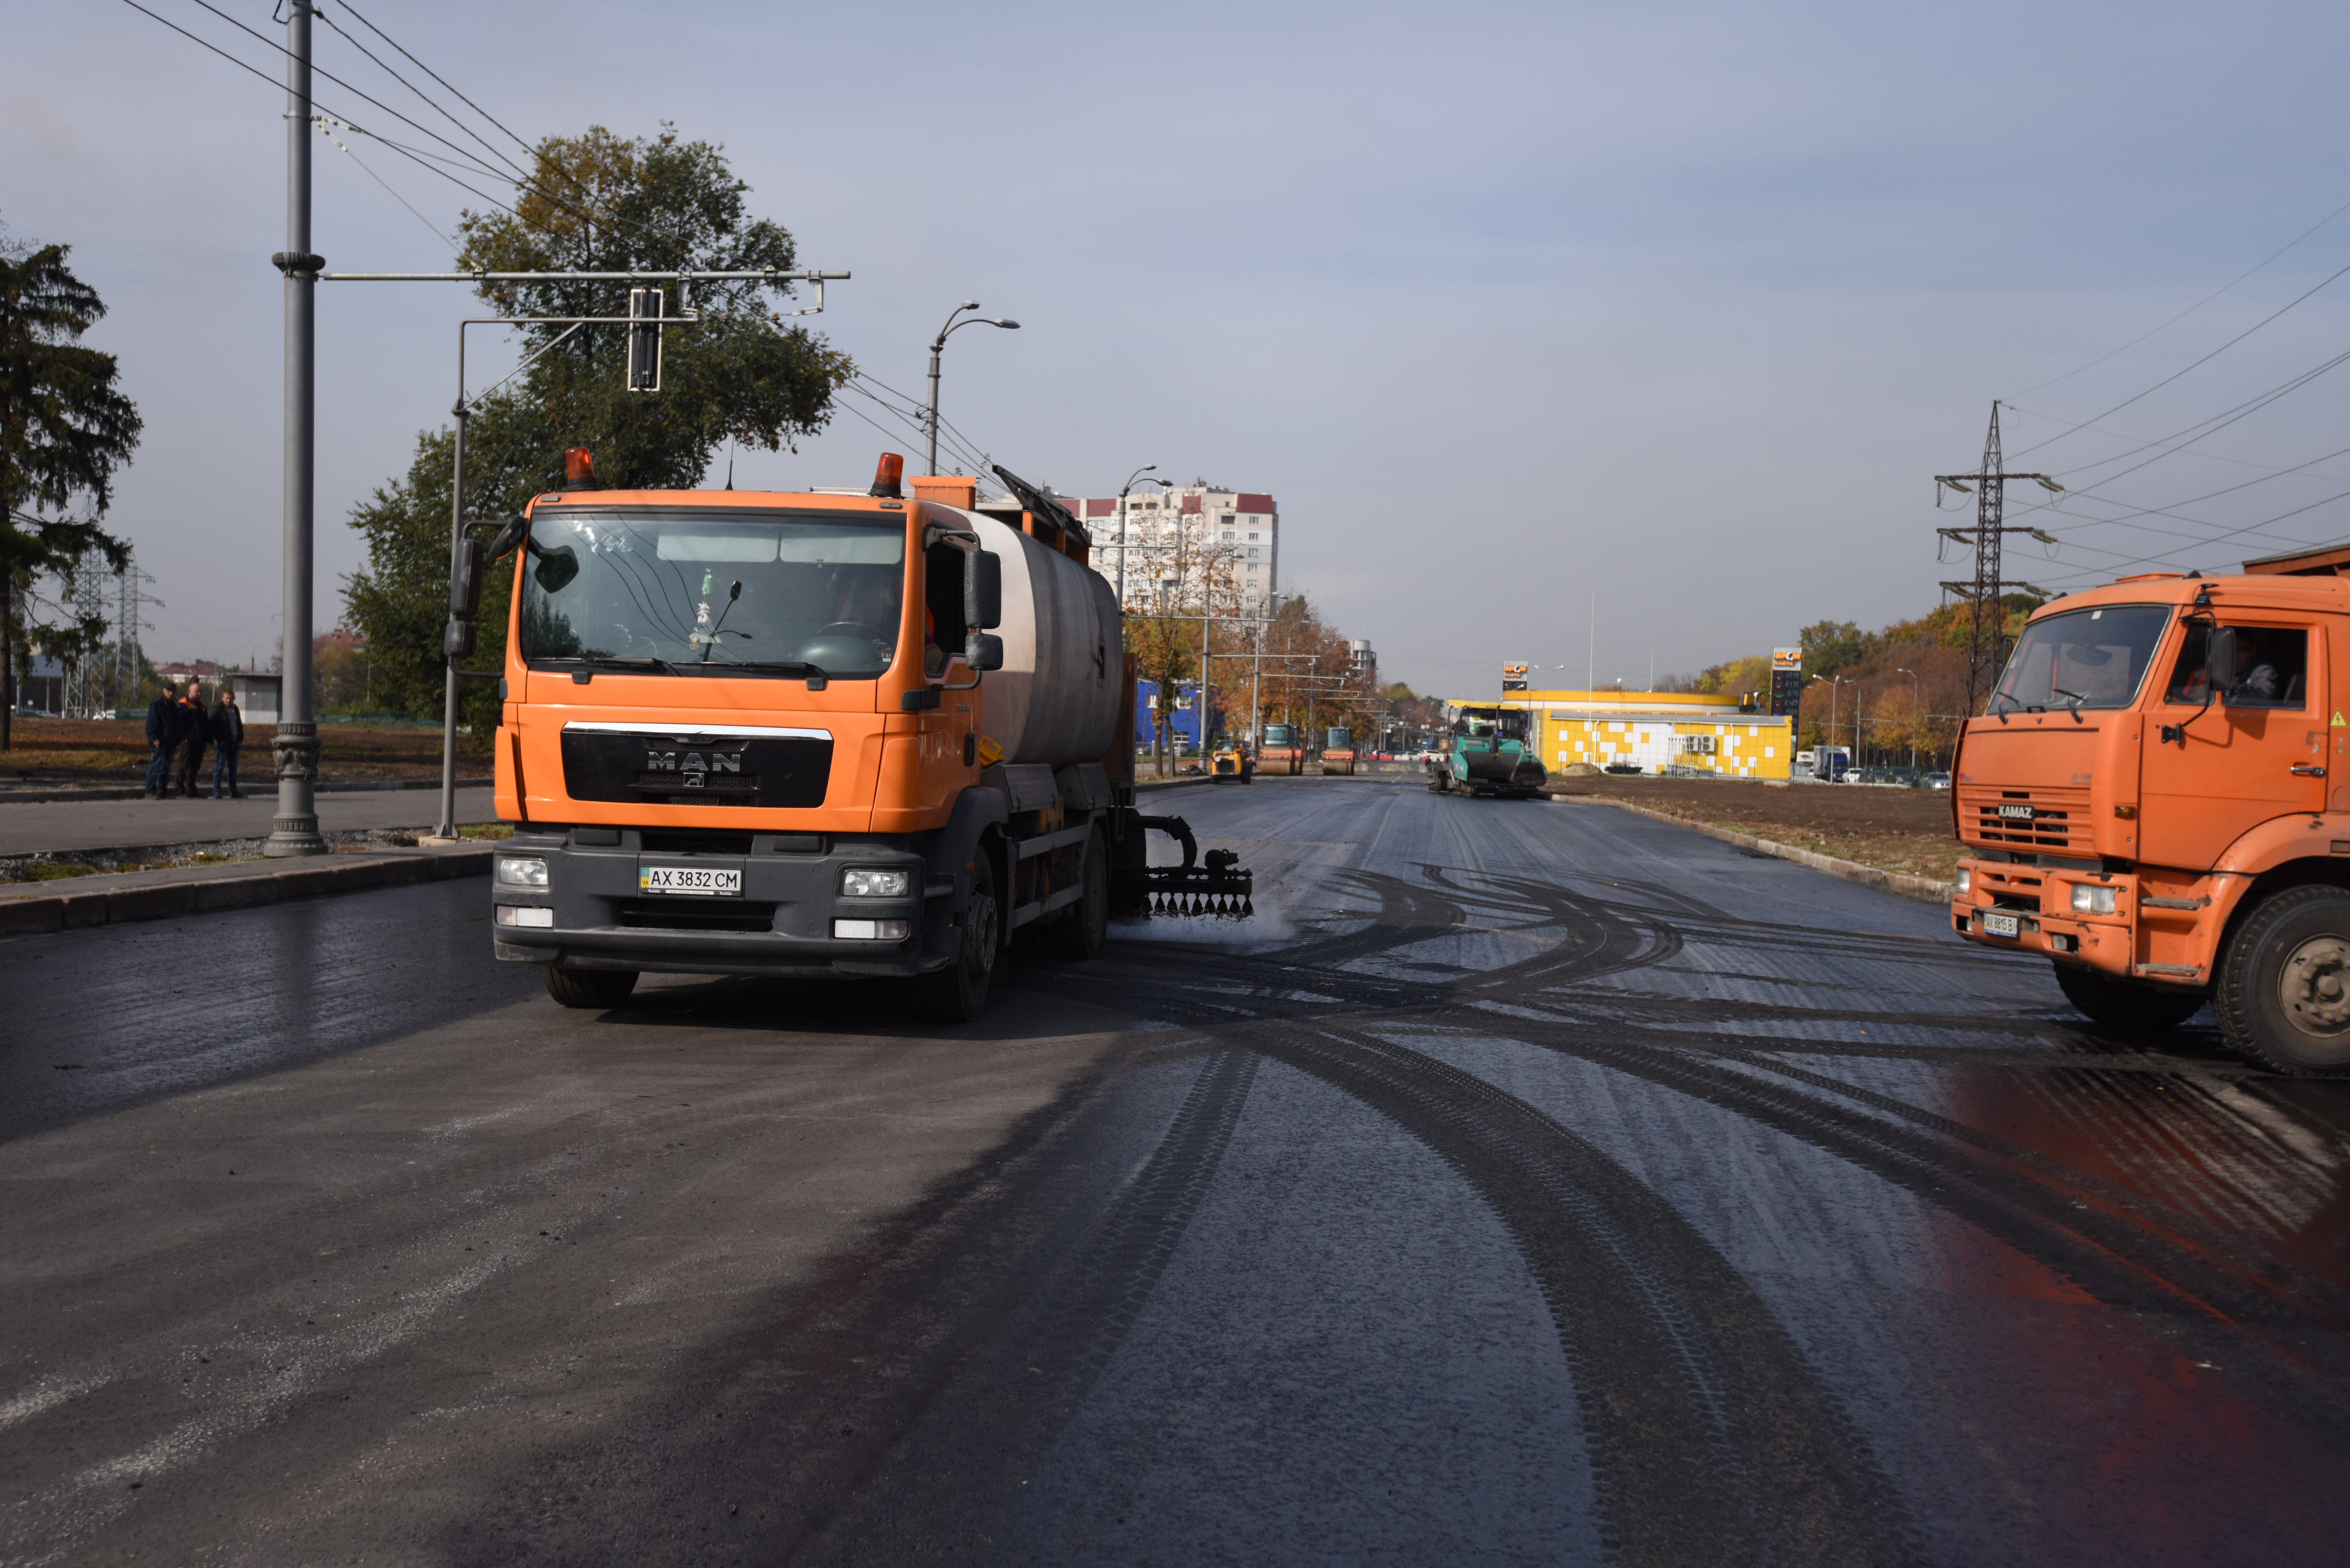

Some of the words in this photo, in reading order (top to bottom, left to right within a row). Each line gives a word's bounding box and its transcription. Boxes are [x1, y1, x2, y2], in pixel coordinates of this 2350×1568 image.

[648, 751, 741, 772] MAN
[1998, 805, 2032, 819] KAMAZ
[651, 870, 672, 886] AX
[676, 871, 711, 887] 3832
[715, 873, 737, 888] CM
